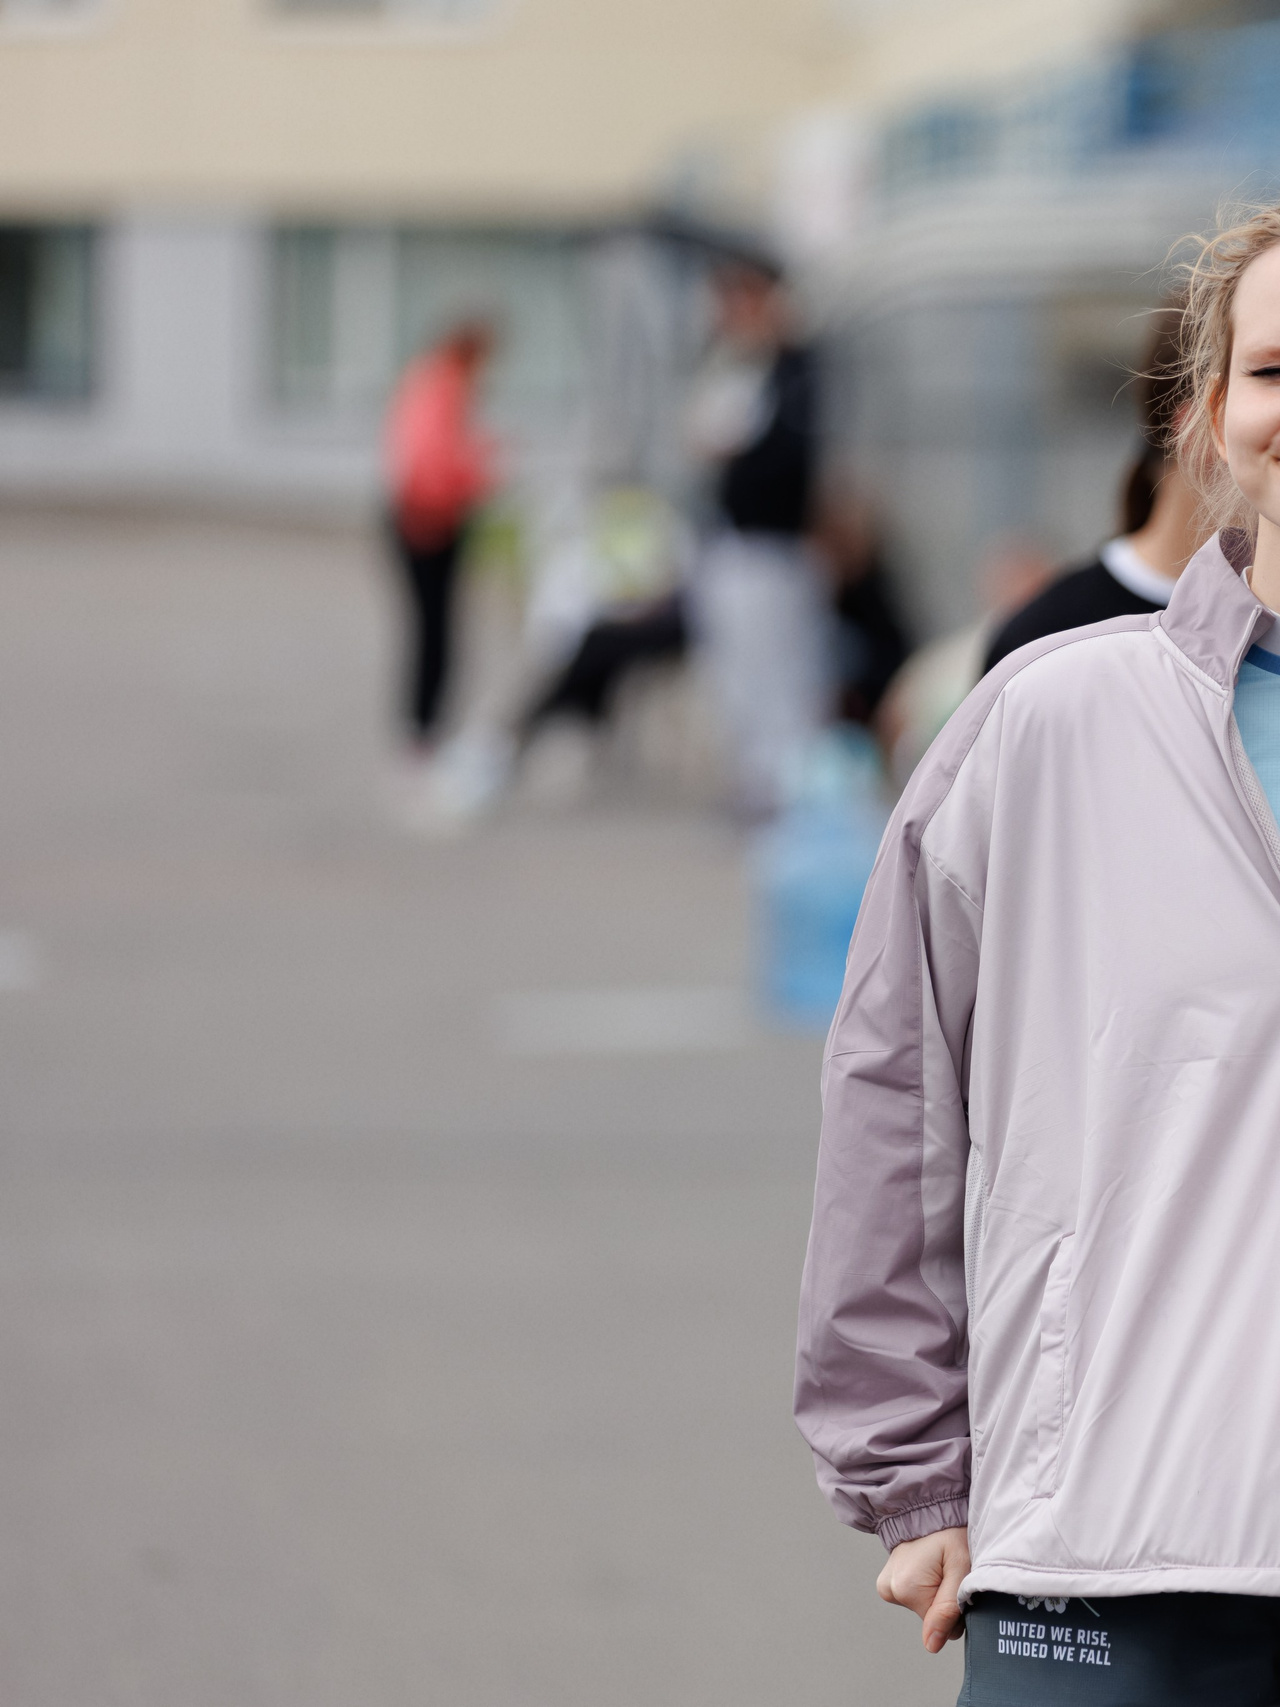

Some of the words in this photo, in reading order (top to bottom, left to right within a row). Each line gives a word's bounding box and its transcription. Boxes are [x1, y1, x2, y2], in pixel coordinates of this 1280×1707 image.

[999, 1620, 1046, 1640] UNITED
[1051, 1626, 1073, 1643] WE
[1077, 1629, 1111, 1649] RISE,
[998, 1639, 1048, 1659] DIVIDED
[1053, 1645, 1074, 1662] WE
[1079, 1648, 1111, 1666] FALL
